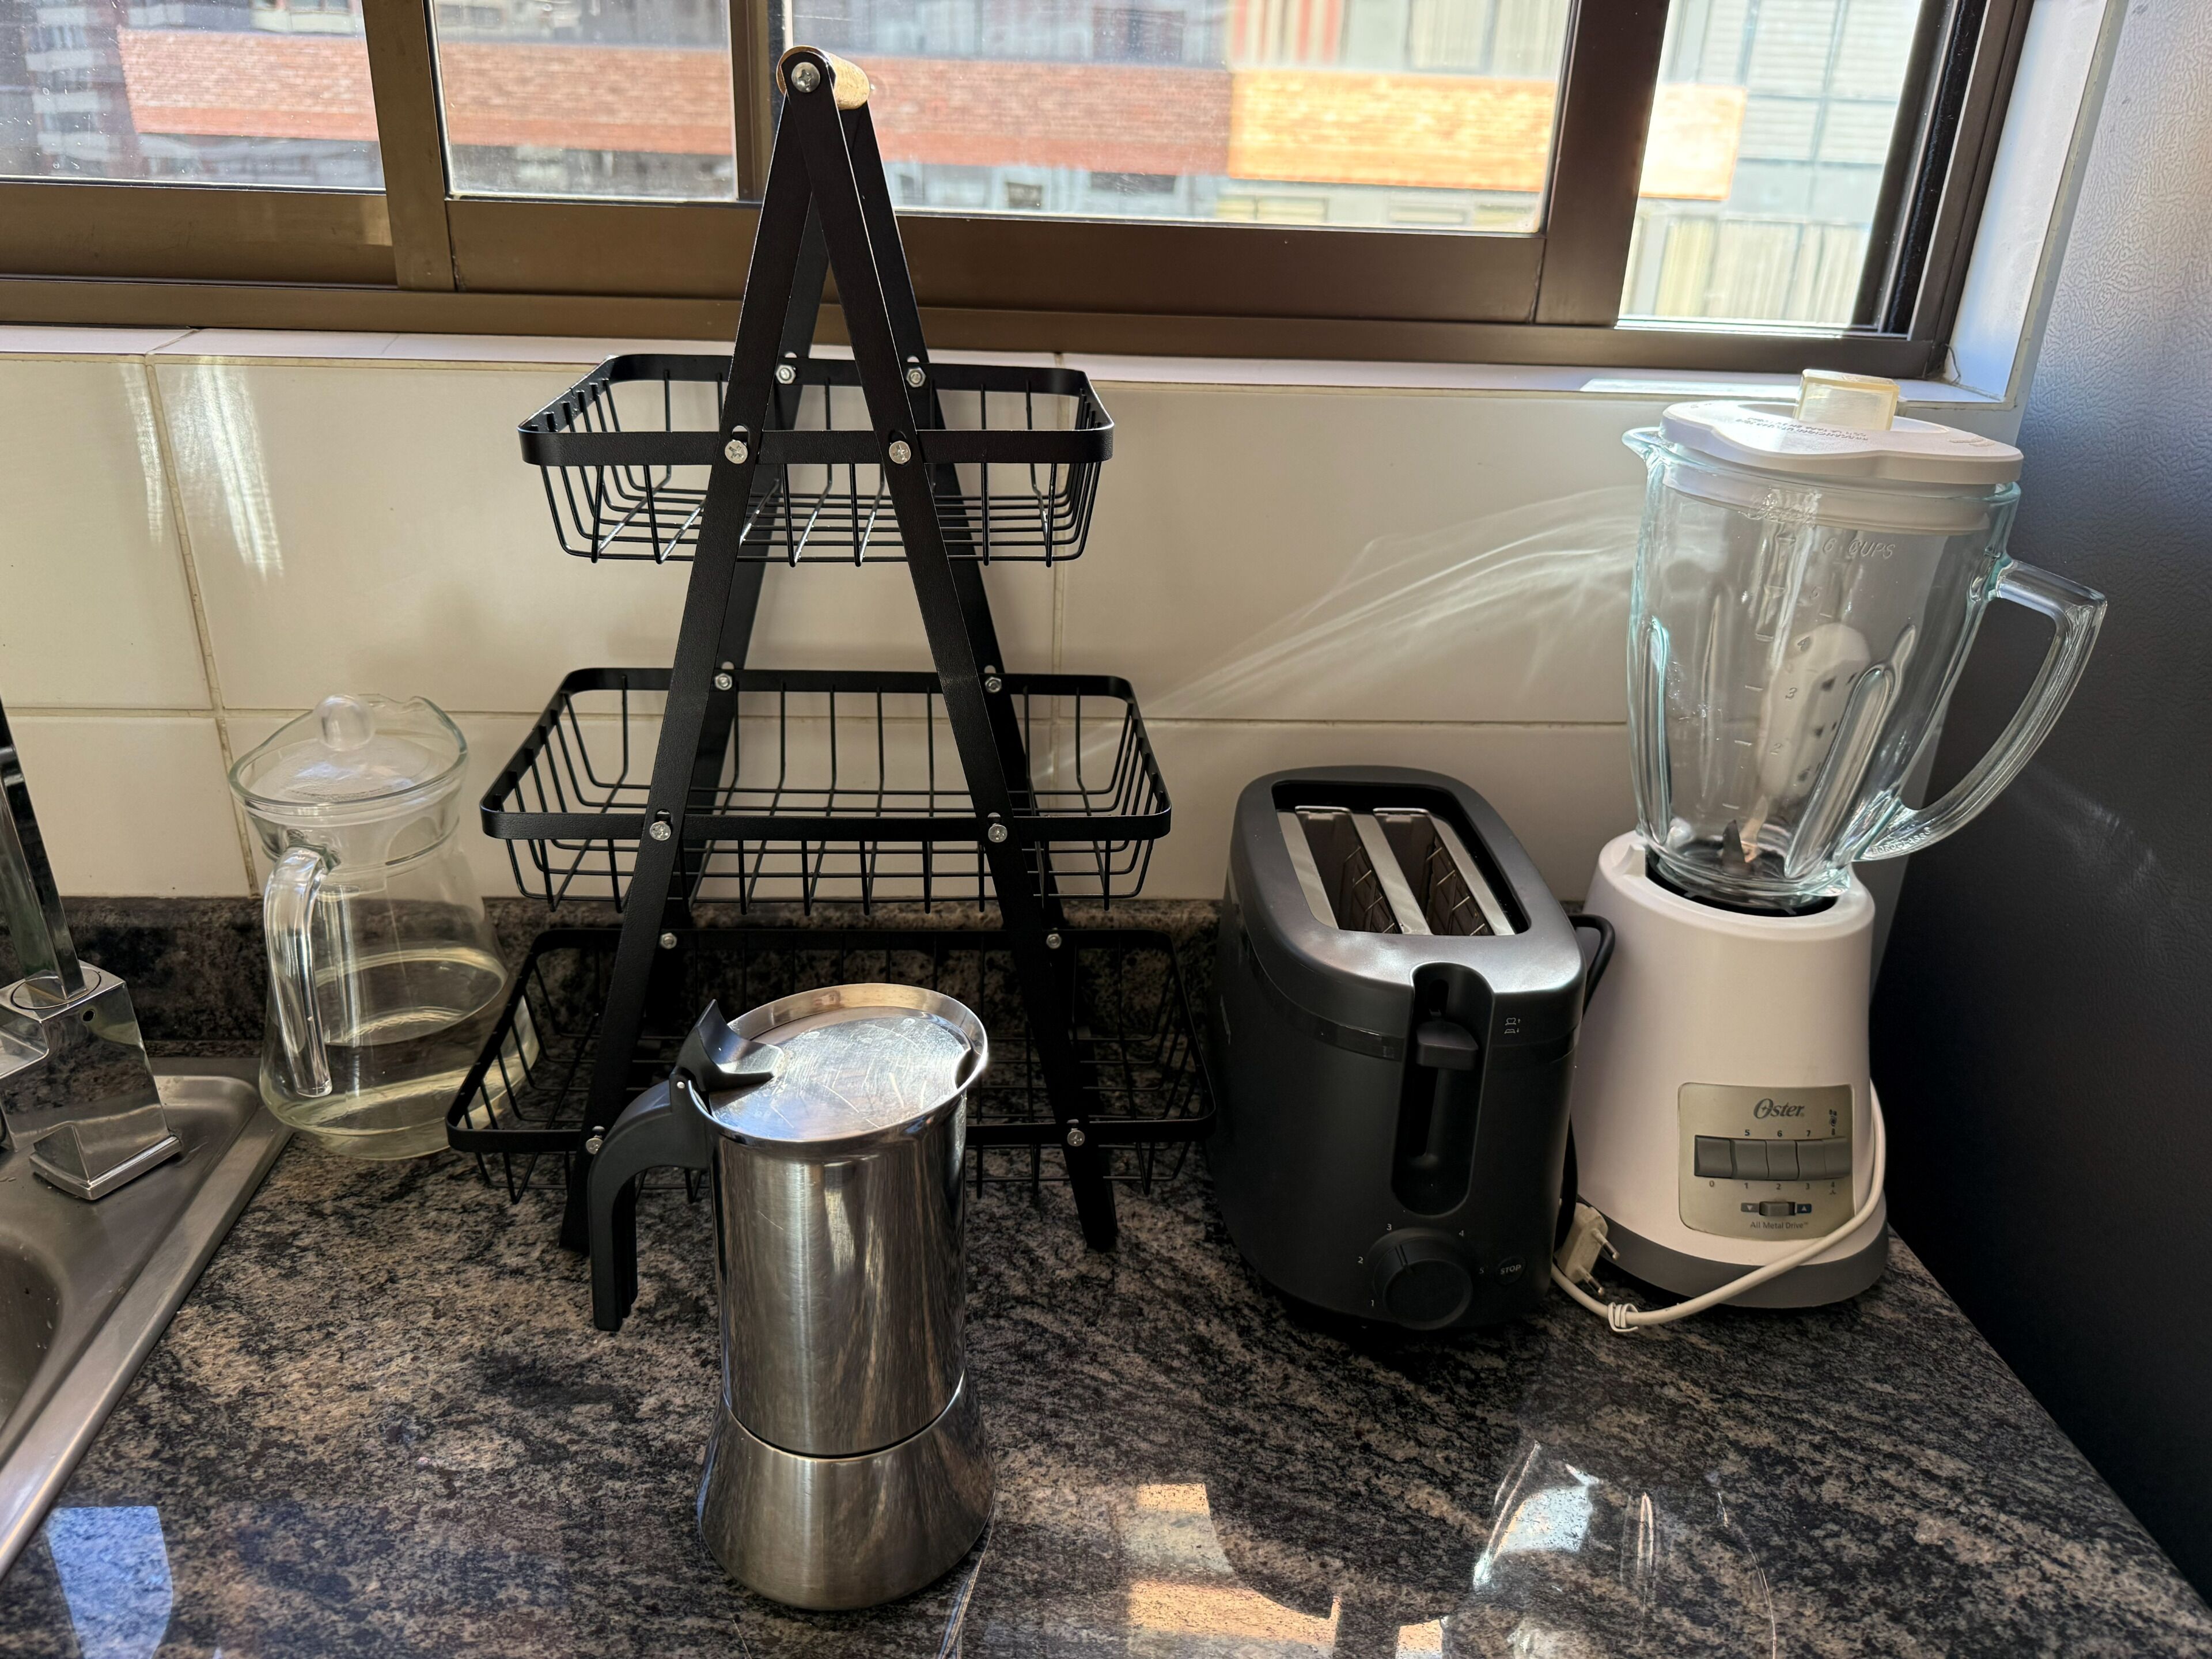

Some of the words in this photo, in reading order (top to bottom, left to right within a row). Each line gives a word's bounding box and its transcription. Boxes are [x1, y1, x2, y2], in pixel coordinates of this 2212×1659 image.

[1847, 539, 1895, 559] CUPS
[1785, 687, 1797, 699] 3
[1753, 1098, 1805, 1119] Oster
[1763, 1221, 1783, 1229] Metal
[1358, 1256, 1364, 1264] 2
[1500, 1264, 1522, 1275] STOP
